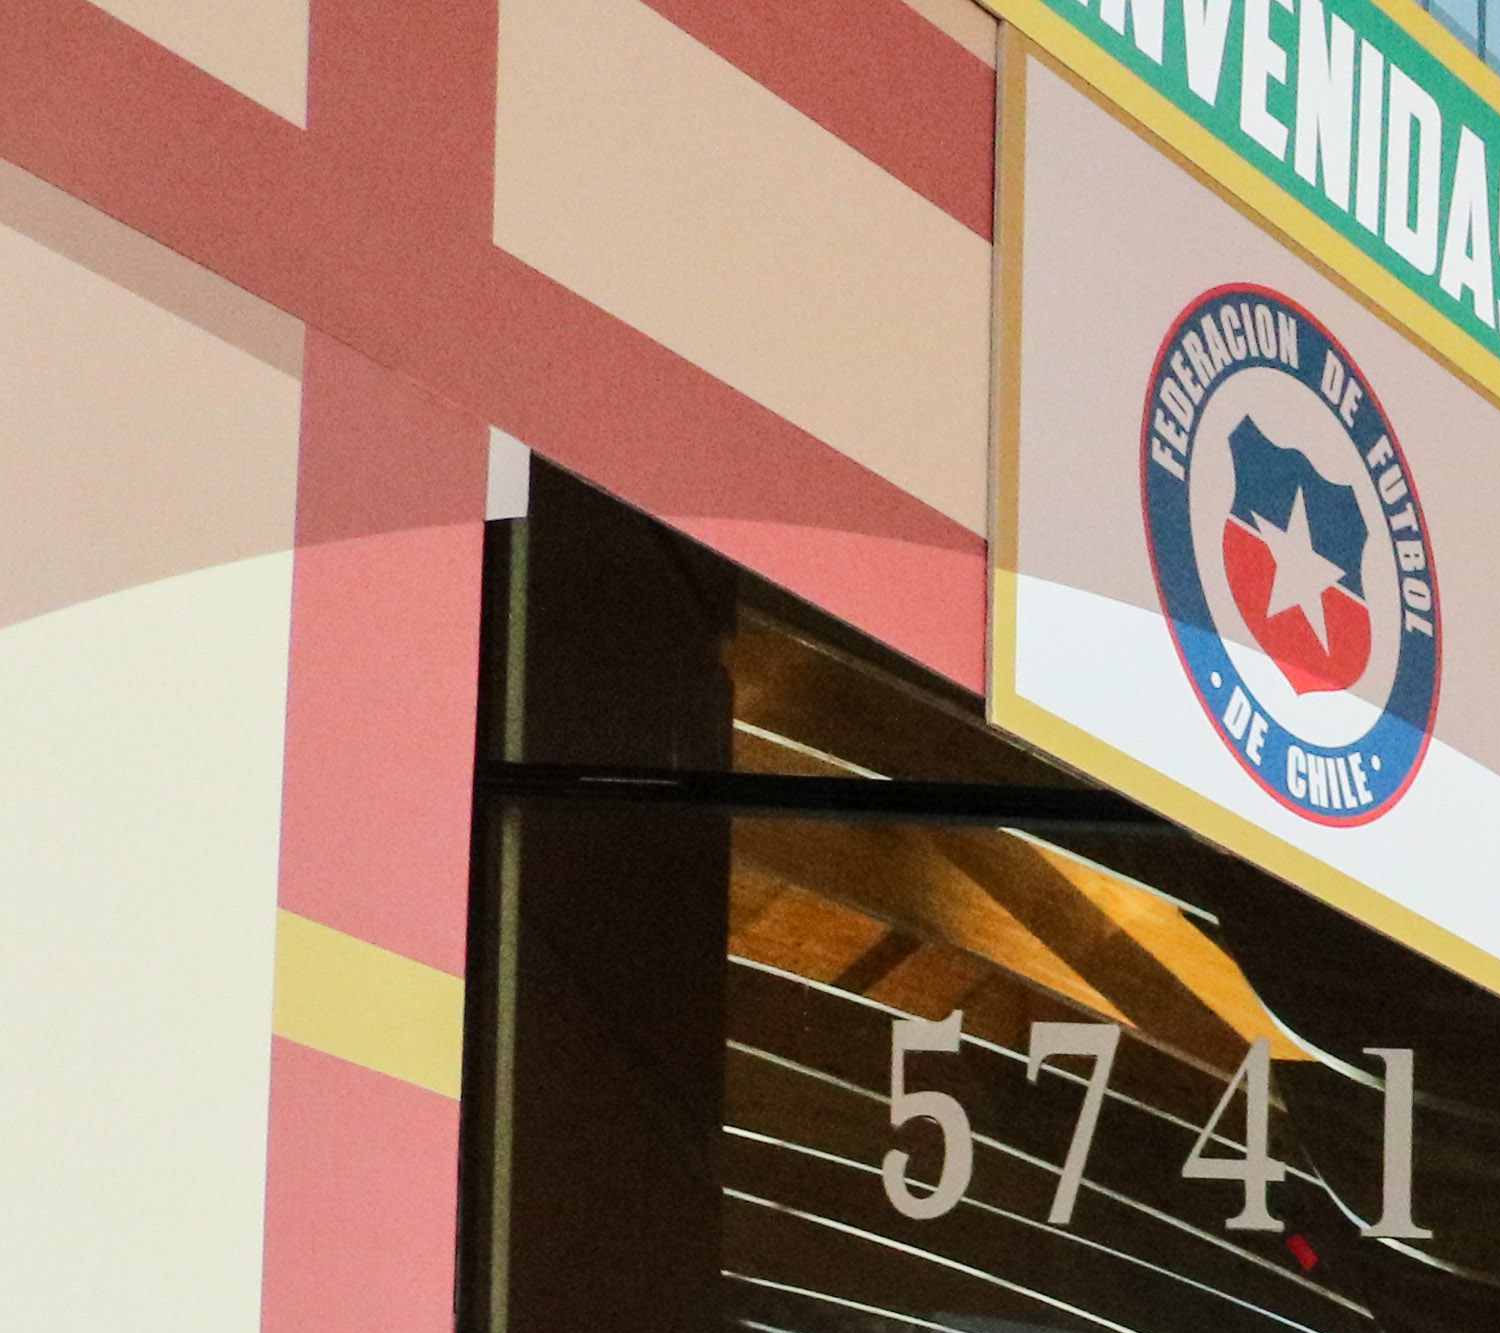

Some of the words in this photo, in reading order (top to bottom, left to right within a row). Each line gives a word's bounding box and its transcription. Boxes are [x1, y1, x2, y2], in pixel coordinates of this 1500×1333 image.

[1151, 302, 1300, 482] FEDERACION
[1320, 348, 1362, 428] DE
[1366, 433, 1434, 637] FUTBOL
[1222, 684, 1268, 767] DE
[1286, 744, 1374, 811] CHILE
